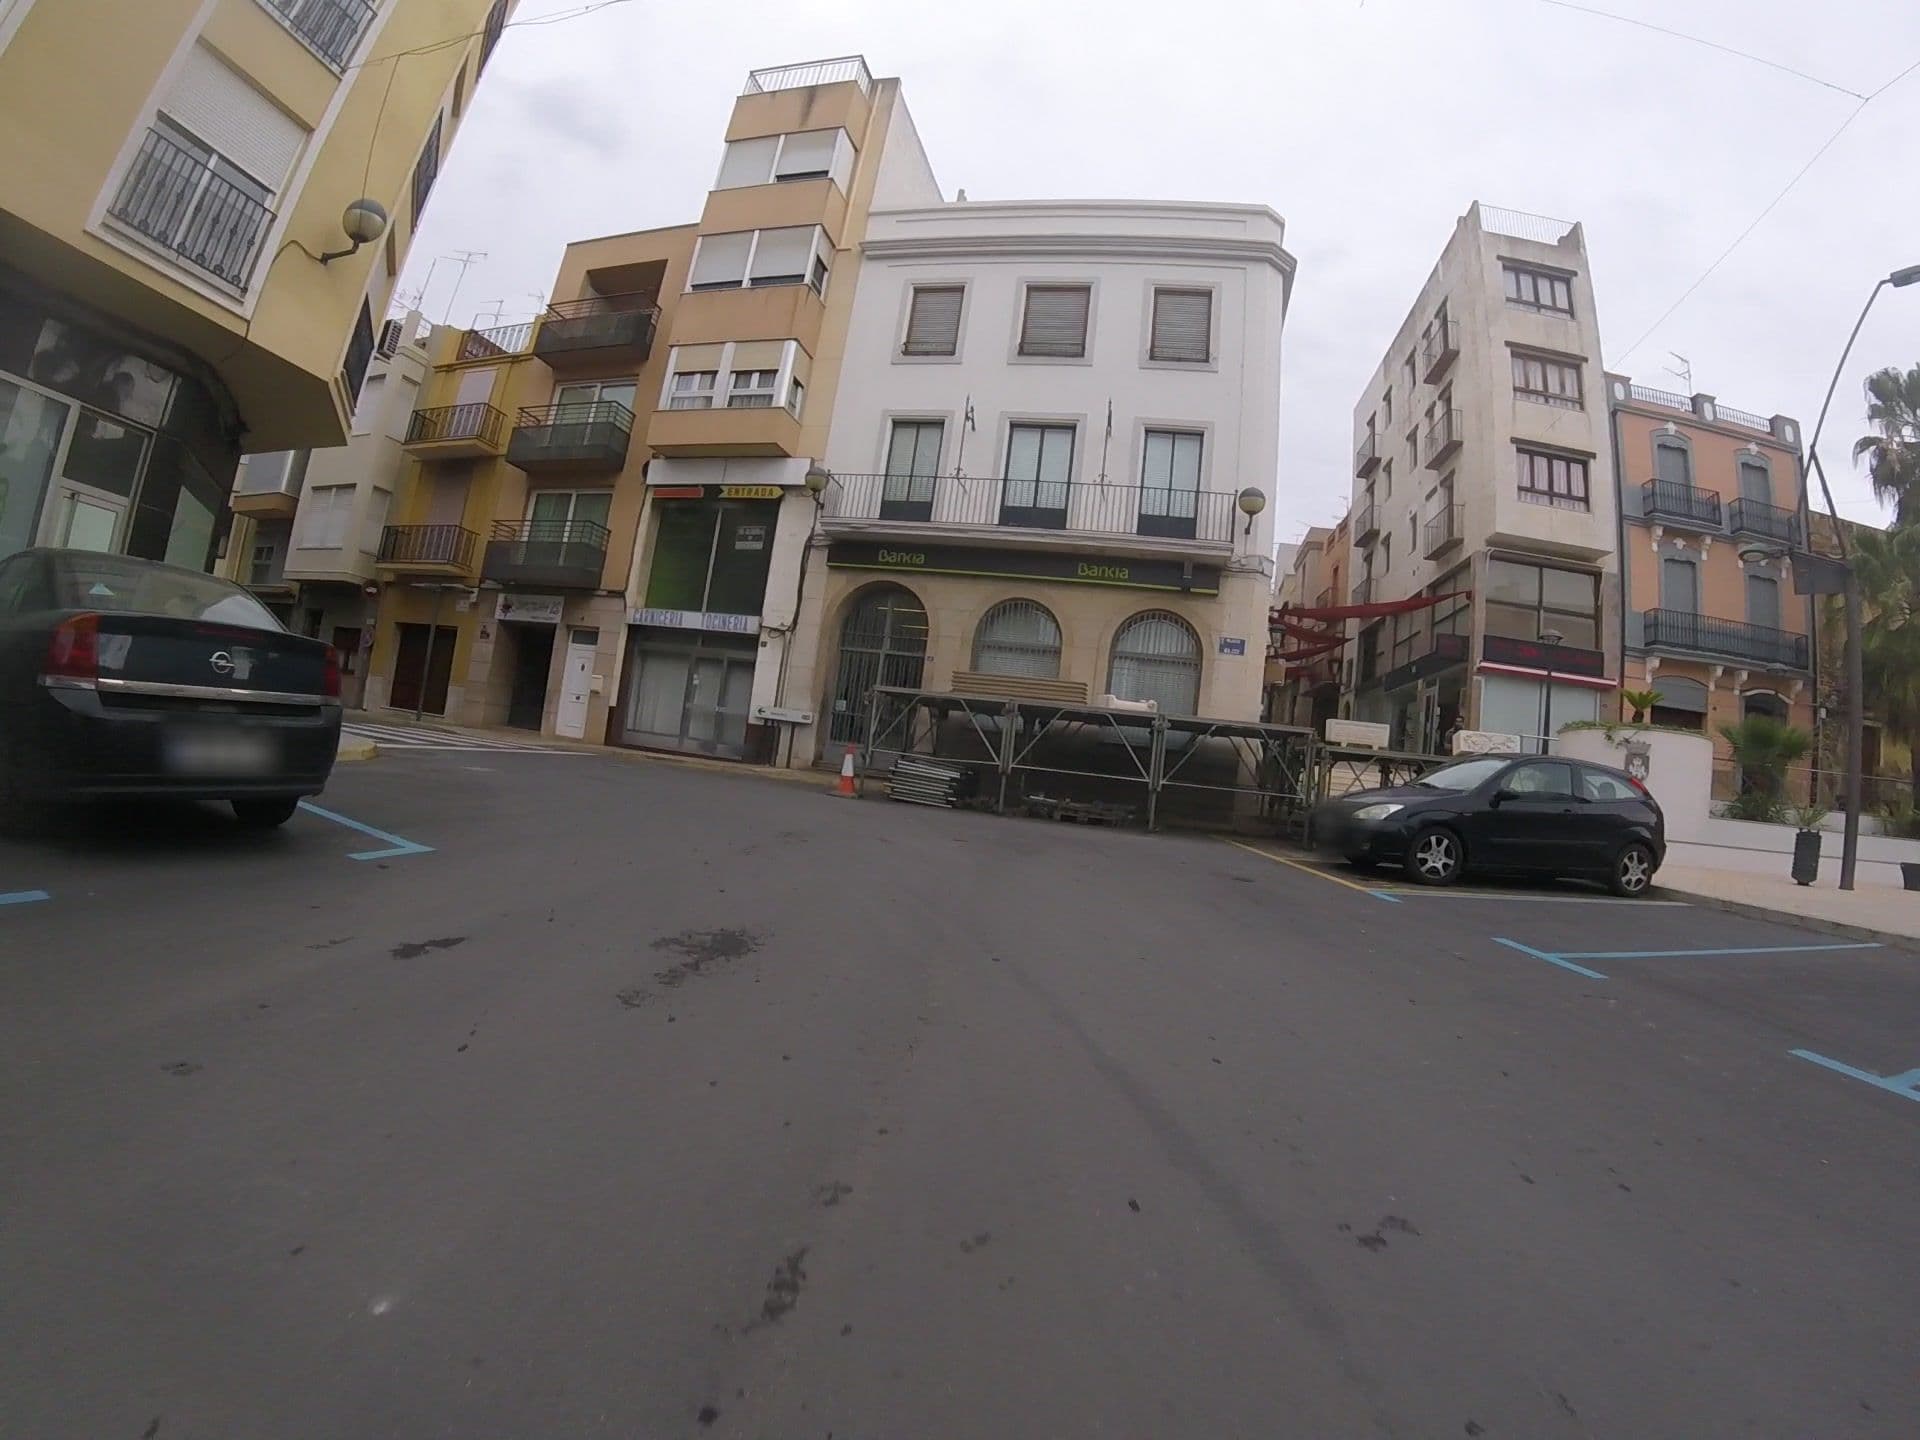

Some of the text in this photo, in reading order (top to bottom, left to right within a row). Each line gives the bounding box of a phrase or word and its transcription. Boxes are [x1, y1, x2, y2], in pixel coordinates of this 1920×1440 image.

[727, 486, 774, 497] ENTRADA
[878, 549, 926, 565] Bankia
[1077, 562, 1129, 580] Bankia
